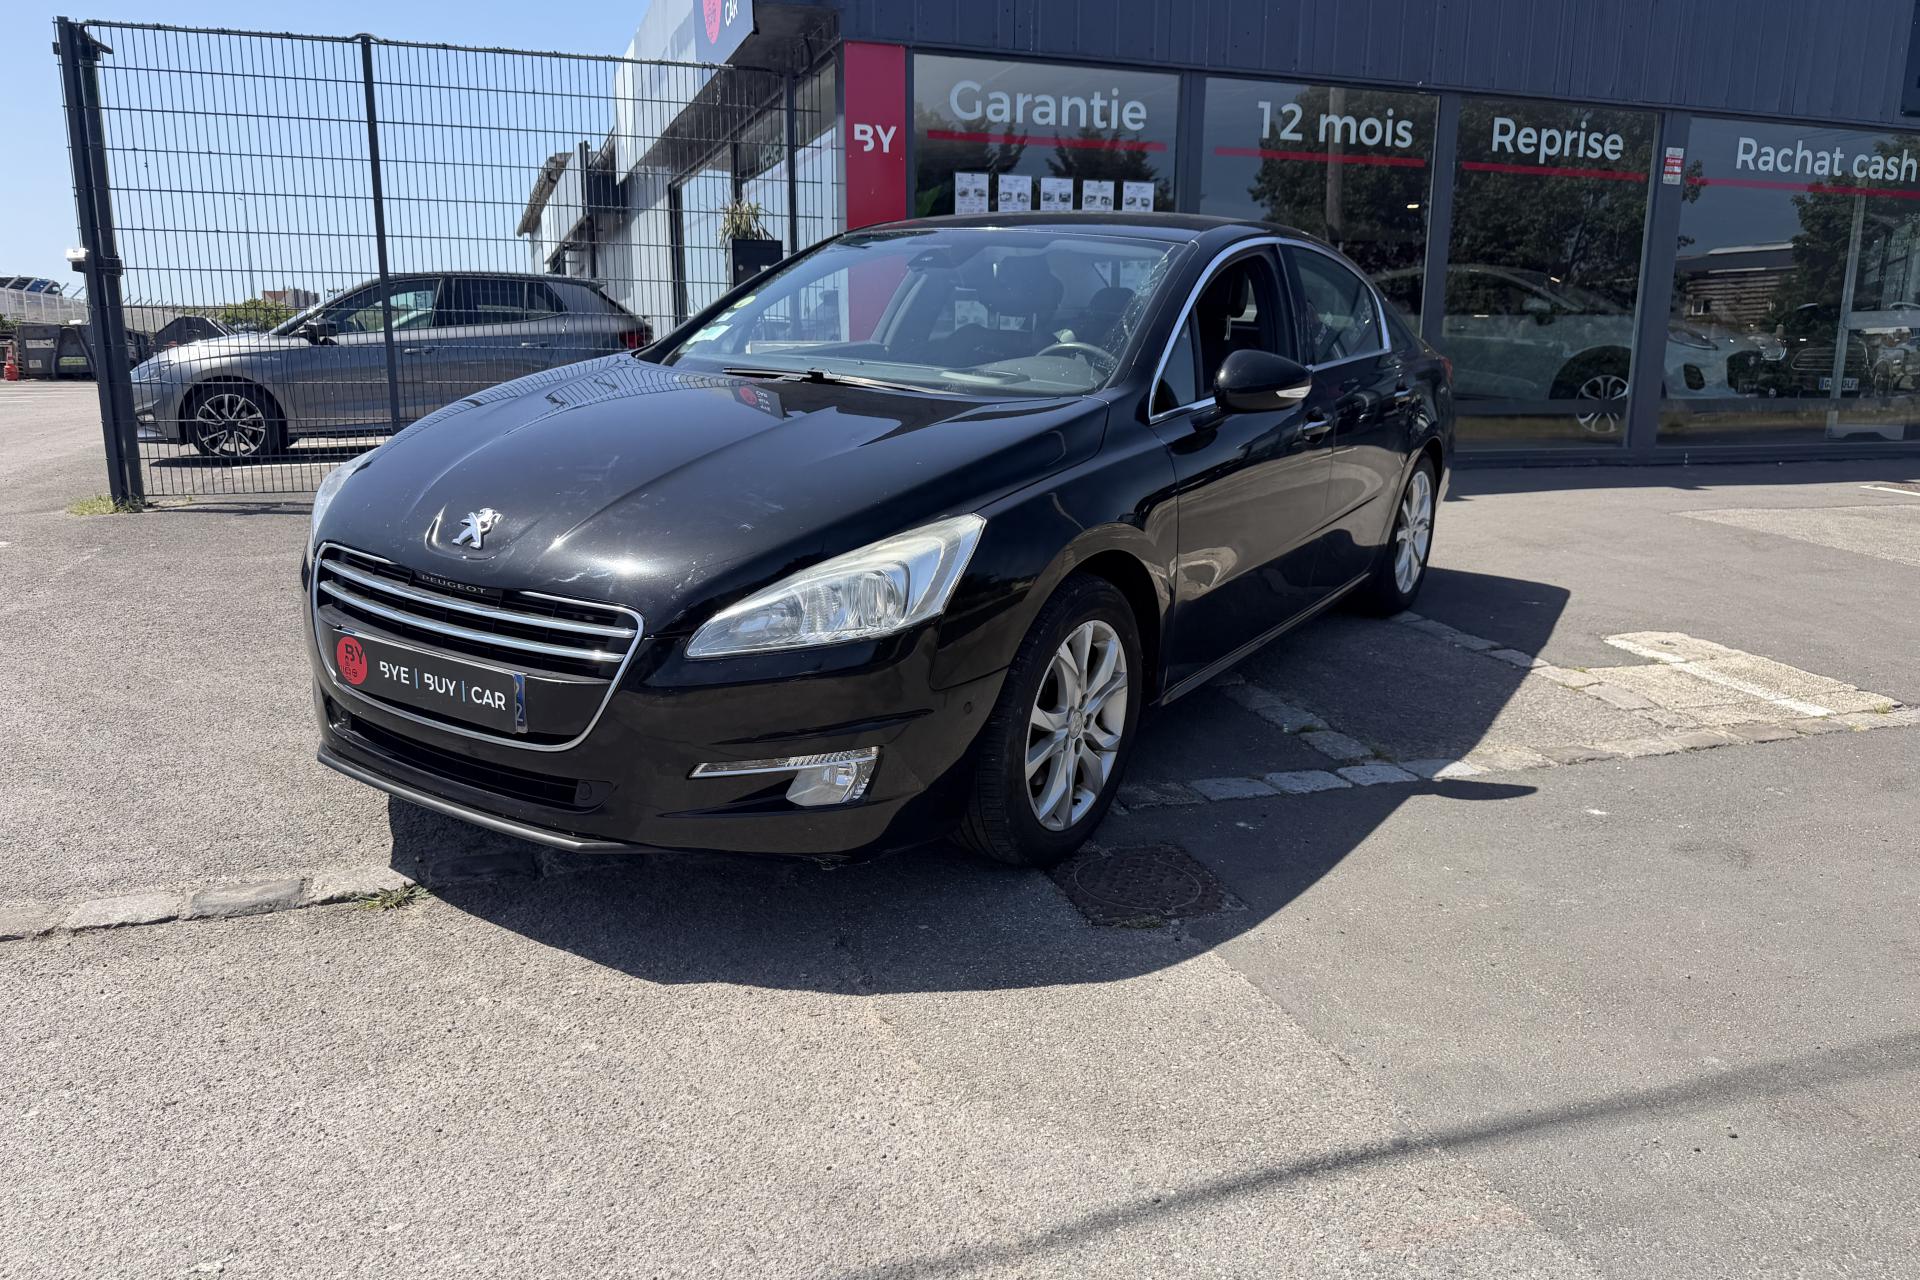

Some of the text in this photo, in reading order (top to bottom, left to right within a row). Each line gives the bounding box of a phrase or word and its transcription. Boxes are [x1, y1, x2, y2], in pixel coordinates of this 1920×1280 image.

[949, 80, 1414, 149] Garantie 12 mois
[853, 123, 898, 154] BY
[1492, 117, 1624, 165] Reprise
[1736, 137, 1918, 183] Rachat cash
[421, 574, 487, 594] PEUGEOT
[379, 660, 410, 685] BYE
[424, 672, 457, 697] BUY
[471, 686, 506, 711] CAR
